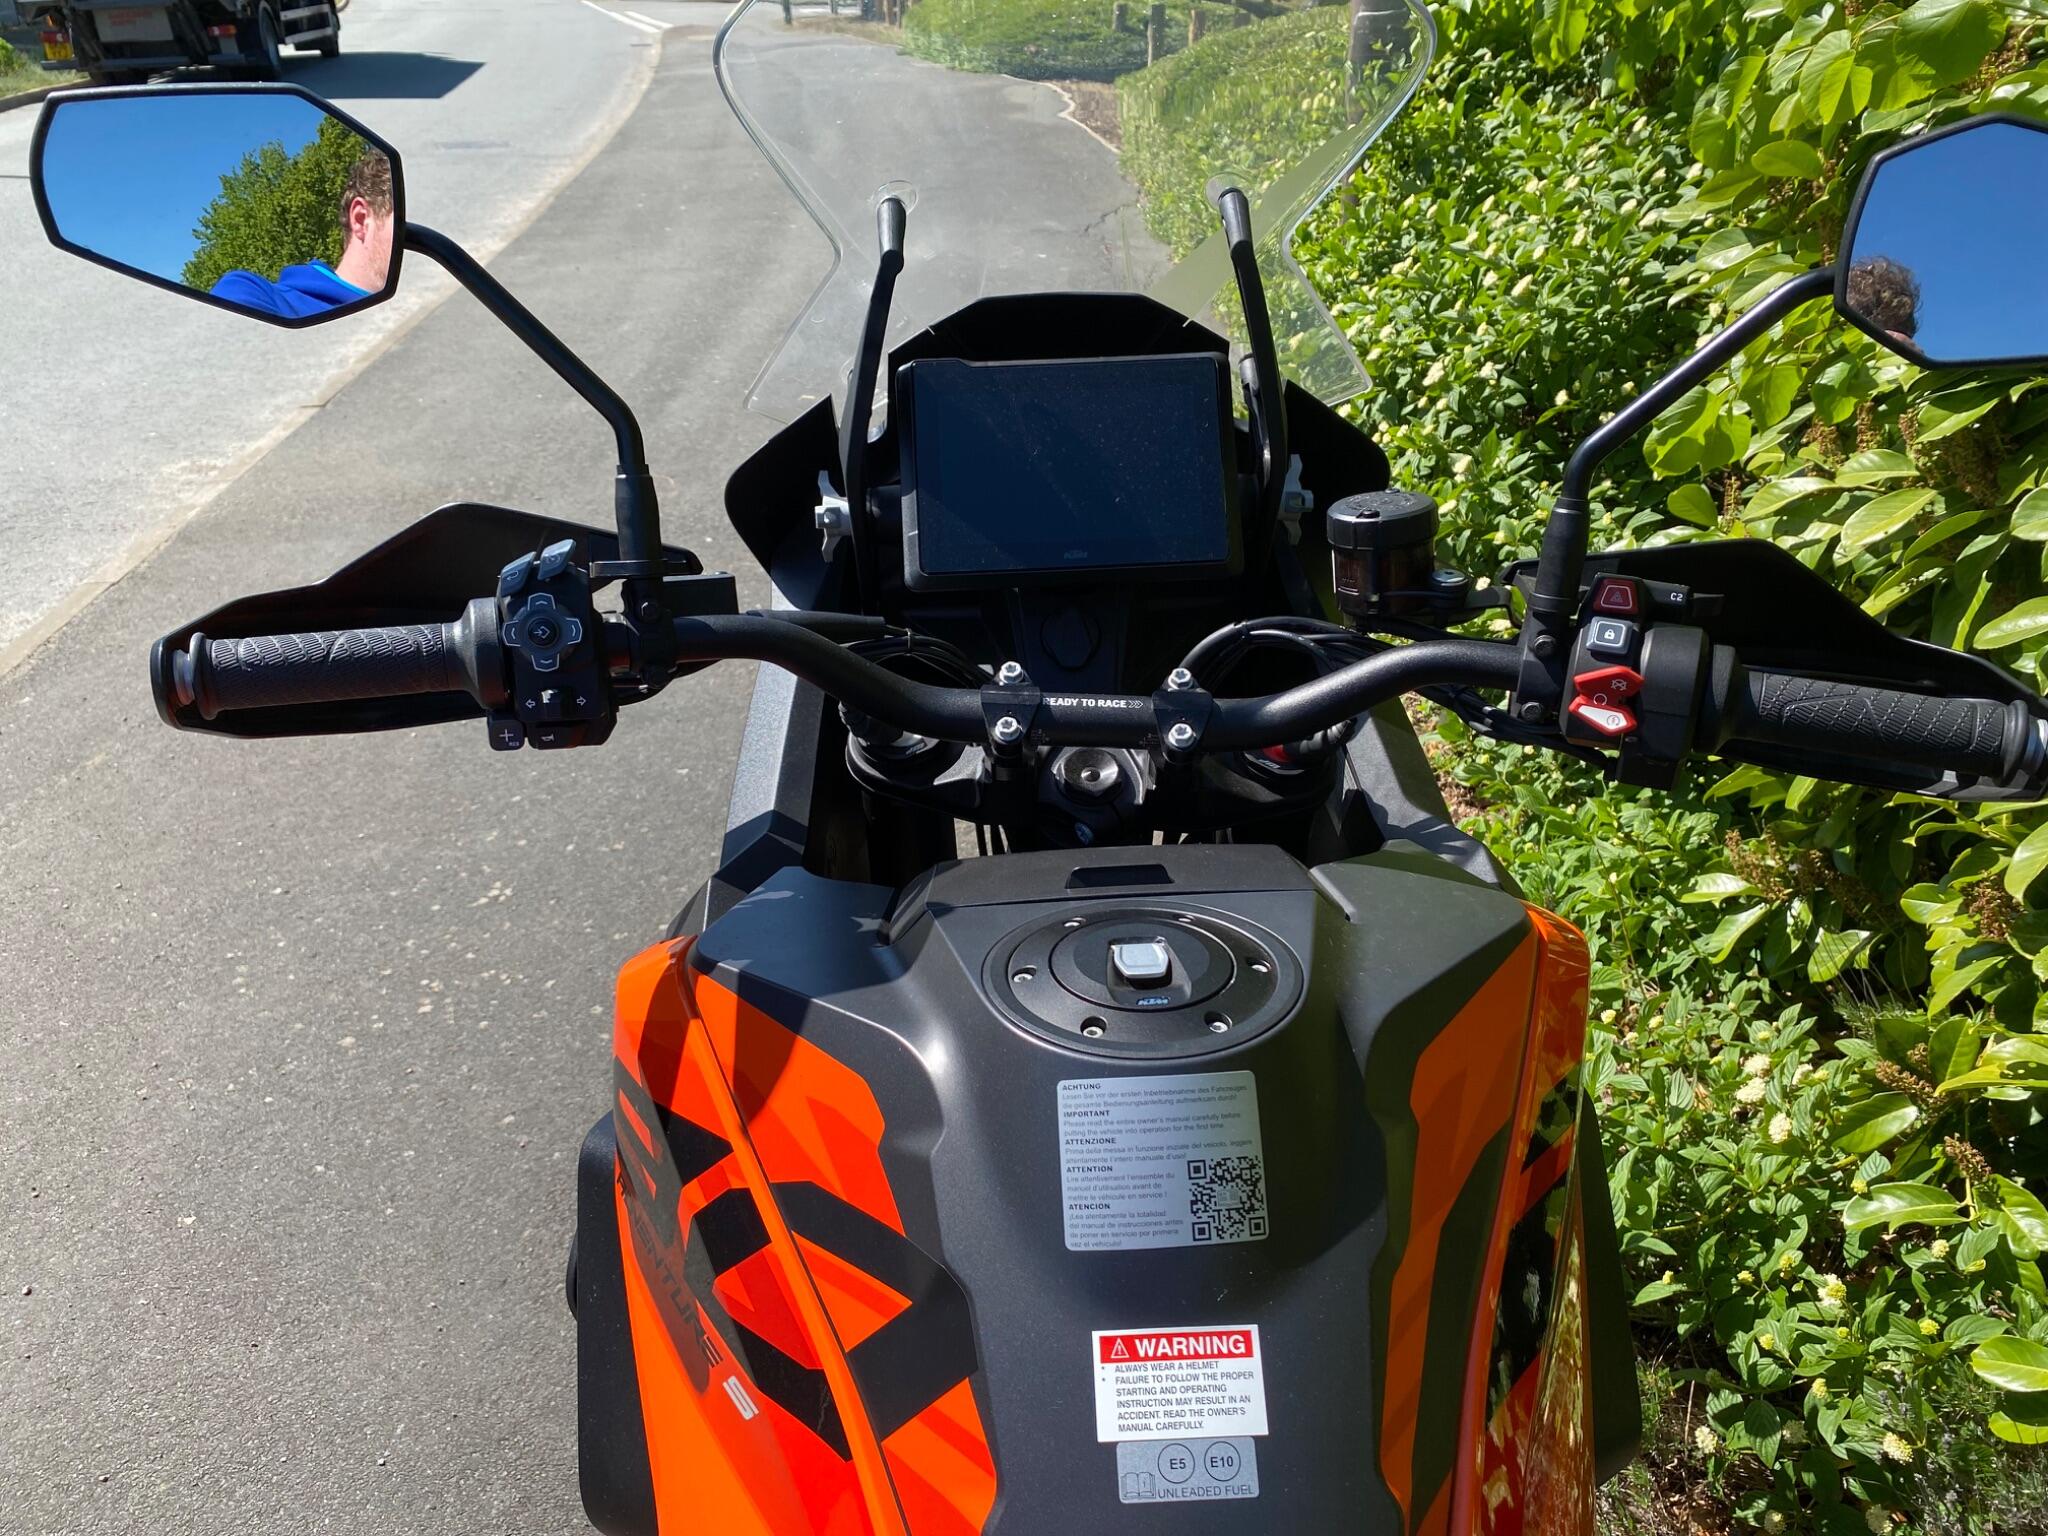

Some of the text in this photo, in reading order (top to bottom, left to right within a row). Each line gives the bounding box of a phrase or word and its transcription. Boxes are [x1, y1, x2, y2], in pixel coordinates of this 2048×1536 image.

[1670, 592, 1683, 601] C2
[1043, 697, 1127, 708] READY TO RACE
[1062, 1083, 1102, 1091] ACHTUNG
[1063, 1110, 1110, 1118] IMPORTANT
[1065, 1137, 1117, 1146] ATTENZIONE
[1066, 1165, 1113, 1173] ATTENTION
[1068, 1203, 1111, 1211] ATENCION
[1135, 1334, 1246, 1358] WARNING
[1114, 1360, 1220, 1373] ALWAYS WEAR A HELMET
[1115, 1370, 1255, 1385] FAILURE TO FOLLOW THE PROPER
[1116, 1384, 1228, 1397] STARTING AND OPERATING
[722, 1375, 760, 1421] S
[1116, 1394, 1252, 1409] INSTRUCTION MAY RESULT IN AN
[1118, 1406, 1246, 1421] ACCIDENT. READ THE OWNER'S
[1118, 1422, 1154, 1433] MANUAL
[1169, 1456, 1234, 1470] E5 E10
[1157, 1484, 1254, 1499] UNLEADED FUEL
